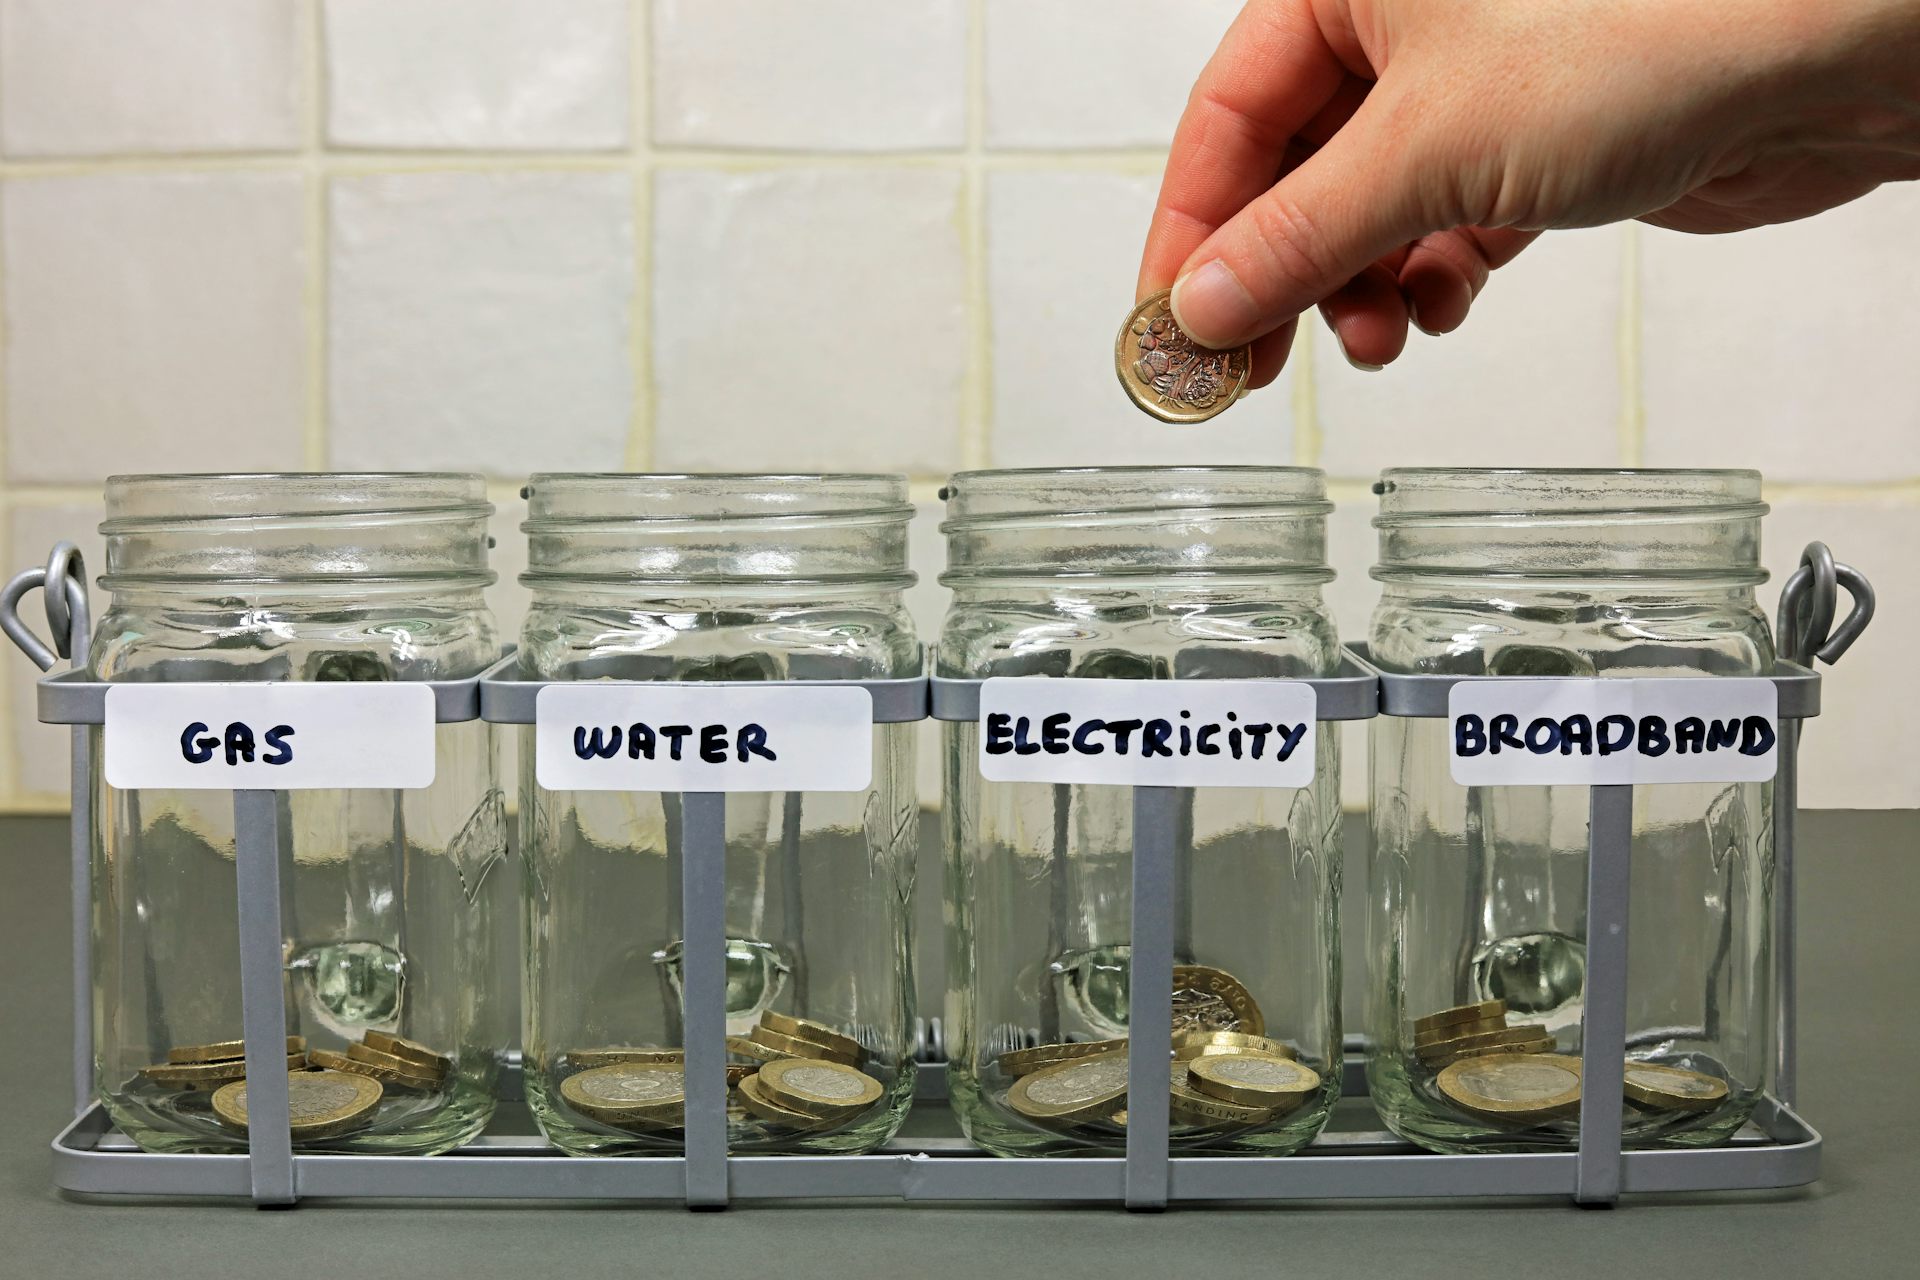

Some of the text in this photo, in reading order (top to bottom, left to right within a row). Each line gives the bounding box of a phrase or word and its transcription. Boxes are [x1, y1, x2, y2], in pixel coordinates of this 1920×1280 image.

[180, 721, 296, 767] GAS
[573, 722, 777, 764] WATER
[1455, 713, 1777, 758] BROADBAND
